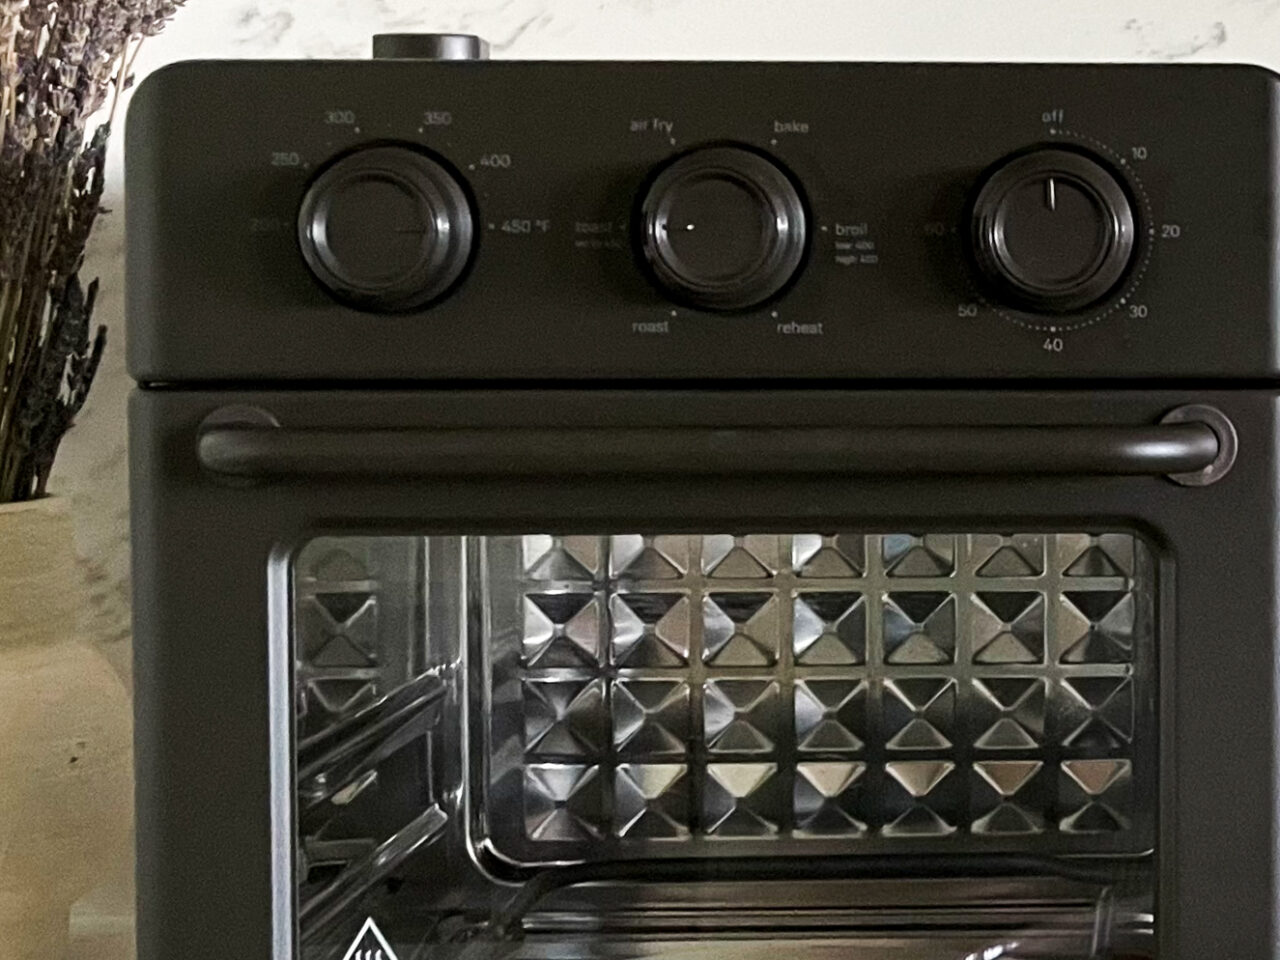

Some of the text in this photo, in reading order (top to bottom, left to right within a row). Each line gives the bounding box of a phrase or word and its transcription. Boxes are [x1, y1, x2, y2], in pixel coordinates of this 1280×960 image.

[324, 110, 356, 125] 300
[423, 110, 453, 126] 350
[1041, 109, 1064, 124] off
[630, 118, 674, 134] air fry
[774, 120, 809, 133] bake
[271, 152, 300, 167] 250
[1131, 146, 1148, 160] 10
[479, 154, 512, 168] 400
[501, 219, 531, 234] 450
[835, 222, 868, 236] broil
[1161, 224, 1181, 238] 20
[957, 304, 978, 318] 50
[1129, 305, 1148, 319] 30
[632, 320, 669, 334] roast
[777, 321, 824, 335] reheat
[1042, 337, 1064, 352] 40
